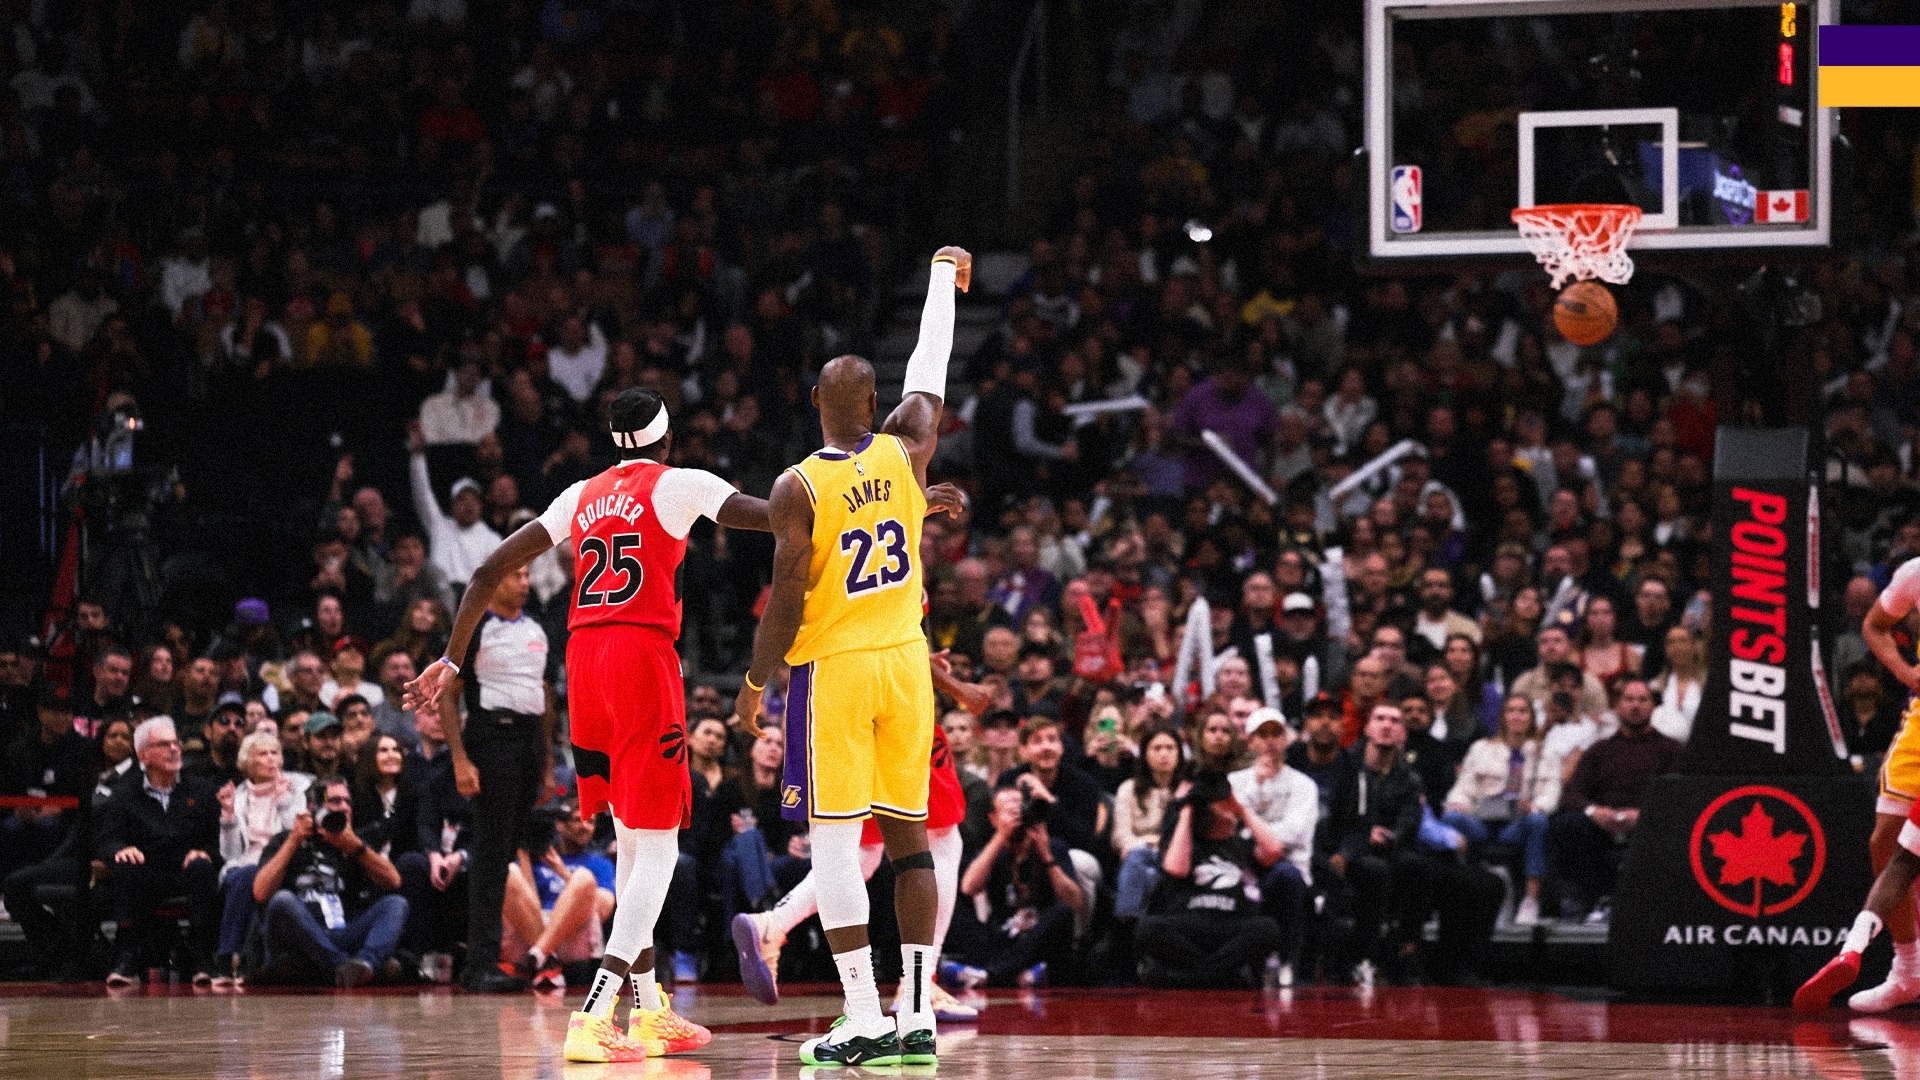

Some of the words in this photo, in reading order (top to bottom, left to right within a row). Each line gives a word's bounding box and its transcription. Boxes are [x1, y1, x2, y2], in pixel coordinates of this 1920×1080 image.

[577, 494, 644, 533] BOUCHER
[842, 479, 892, 513] JAMES
[577, 532, 644, 608] 25
[840, 517, 912, 600] 23
[1664, 925, 1716, 945] AIR
